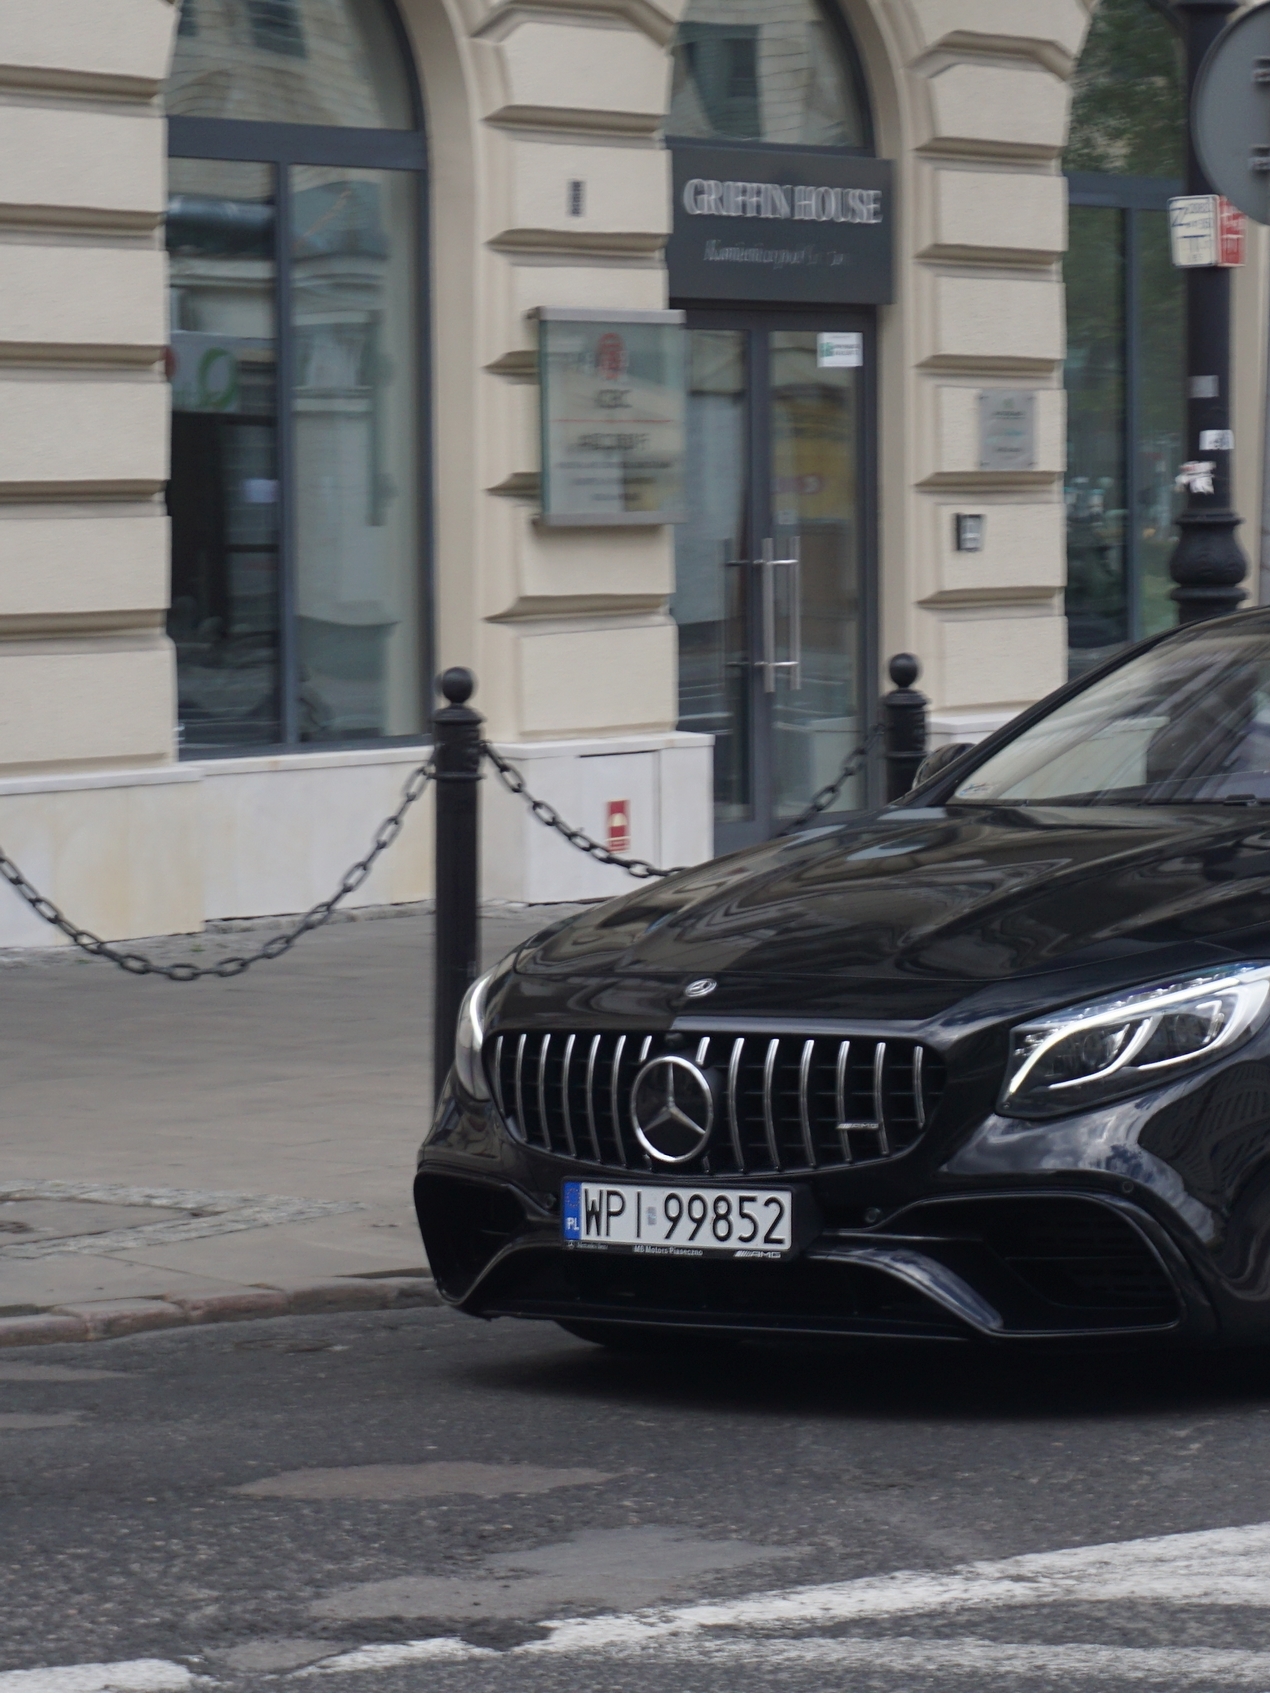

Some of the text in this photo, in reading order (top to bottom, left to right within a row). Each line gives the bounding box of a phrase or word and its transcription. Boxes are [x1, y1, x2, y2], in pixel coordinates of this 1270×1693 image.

[683, 178, 883, 224] GRIFFIN HOUSE
[567, 1217, 580, 1231] PL
[664, 1192, 786, 1245] 99852
